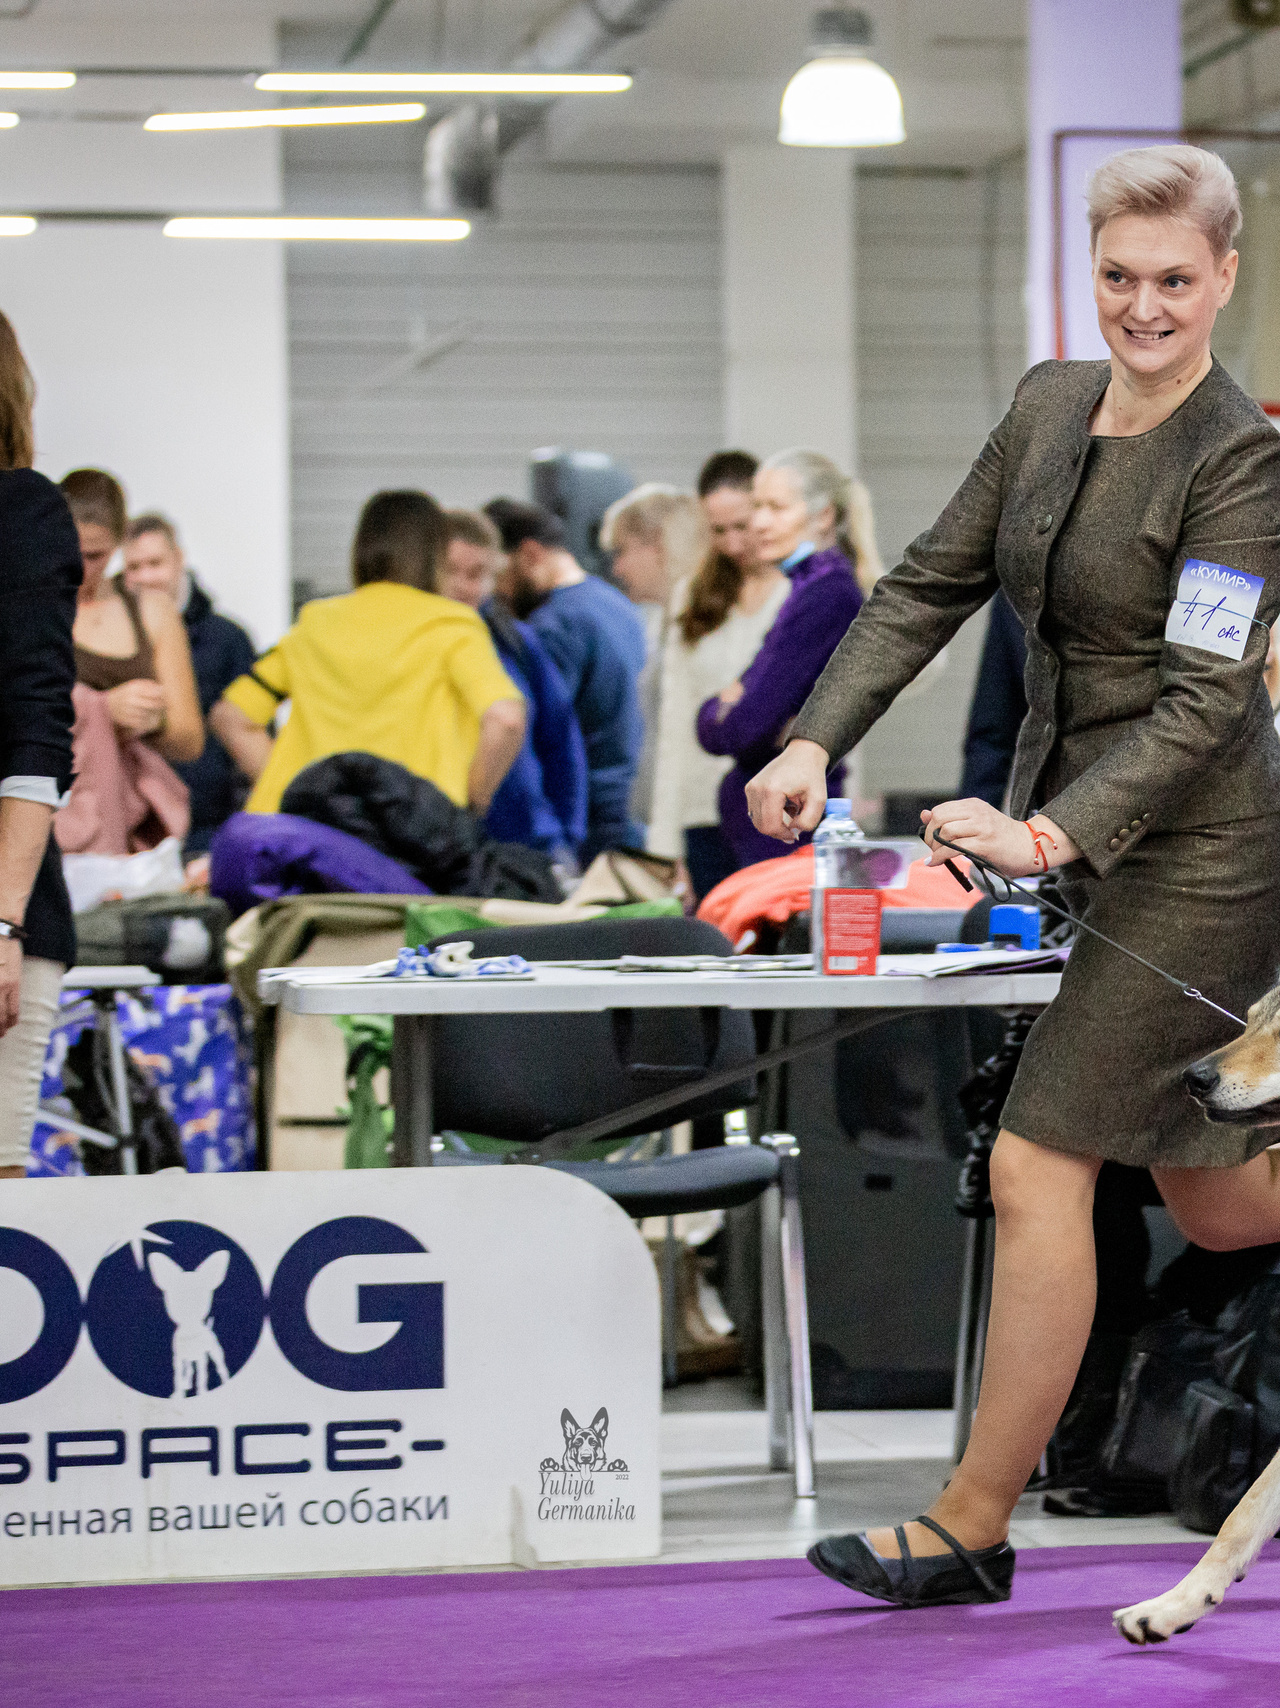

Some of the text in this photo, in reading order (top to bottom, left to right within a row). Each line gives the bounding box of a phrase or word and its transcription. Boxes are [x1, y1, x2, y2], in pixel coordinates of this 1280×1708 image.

[1190, 565, 1251, 591] «КУМИР»
[147, 1492, 285, 1533] вашей
[299, 1487, 449, 1526] собаки
